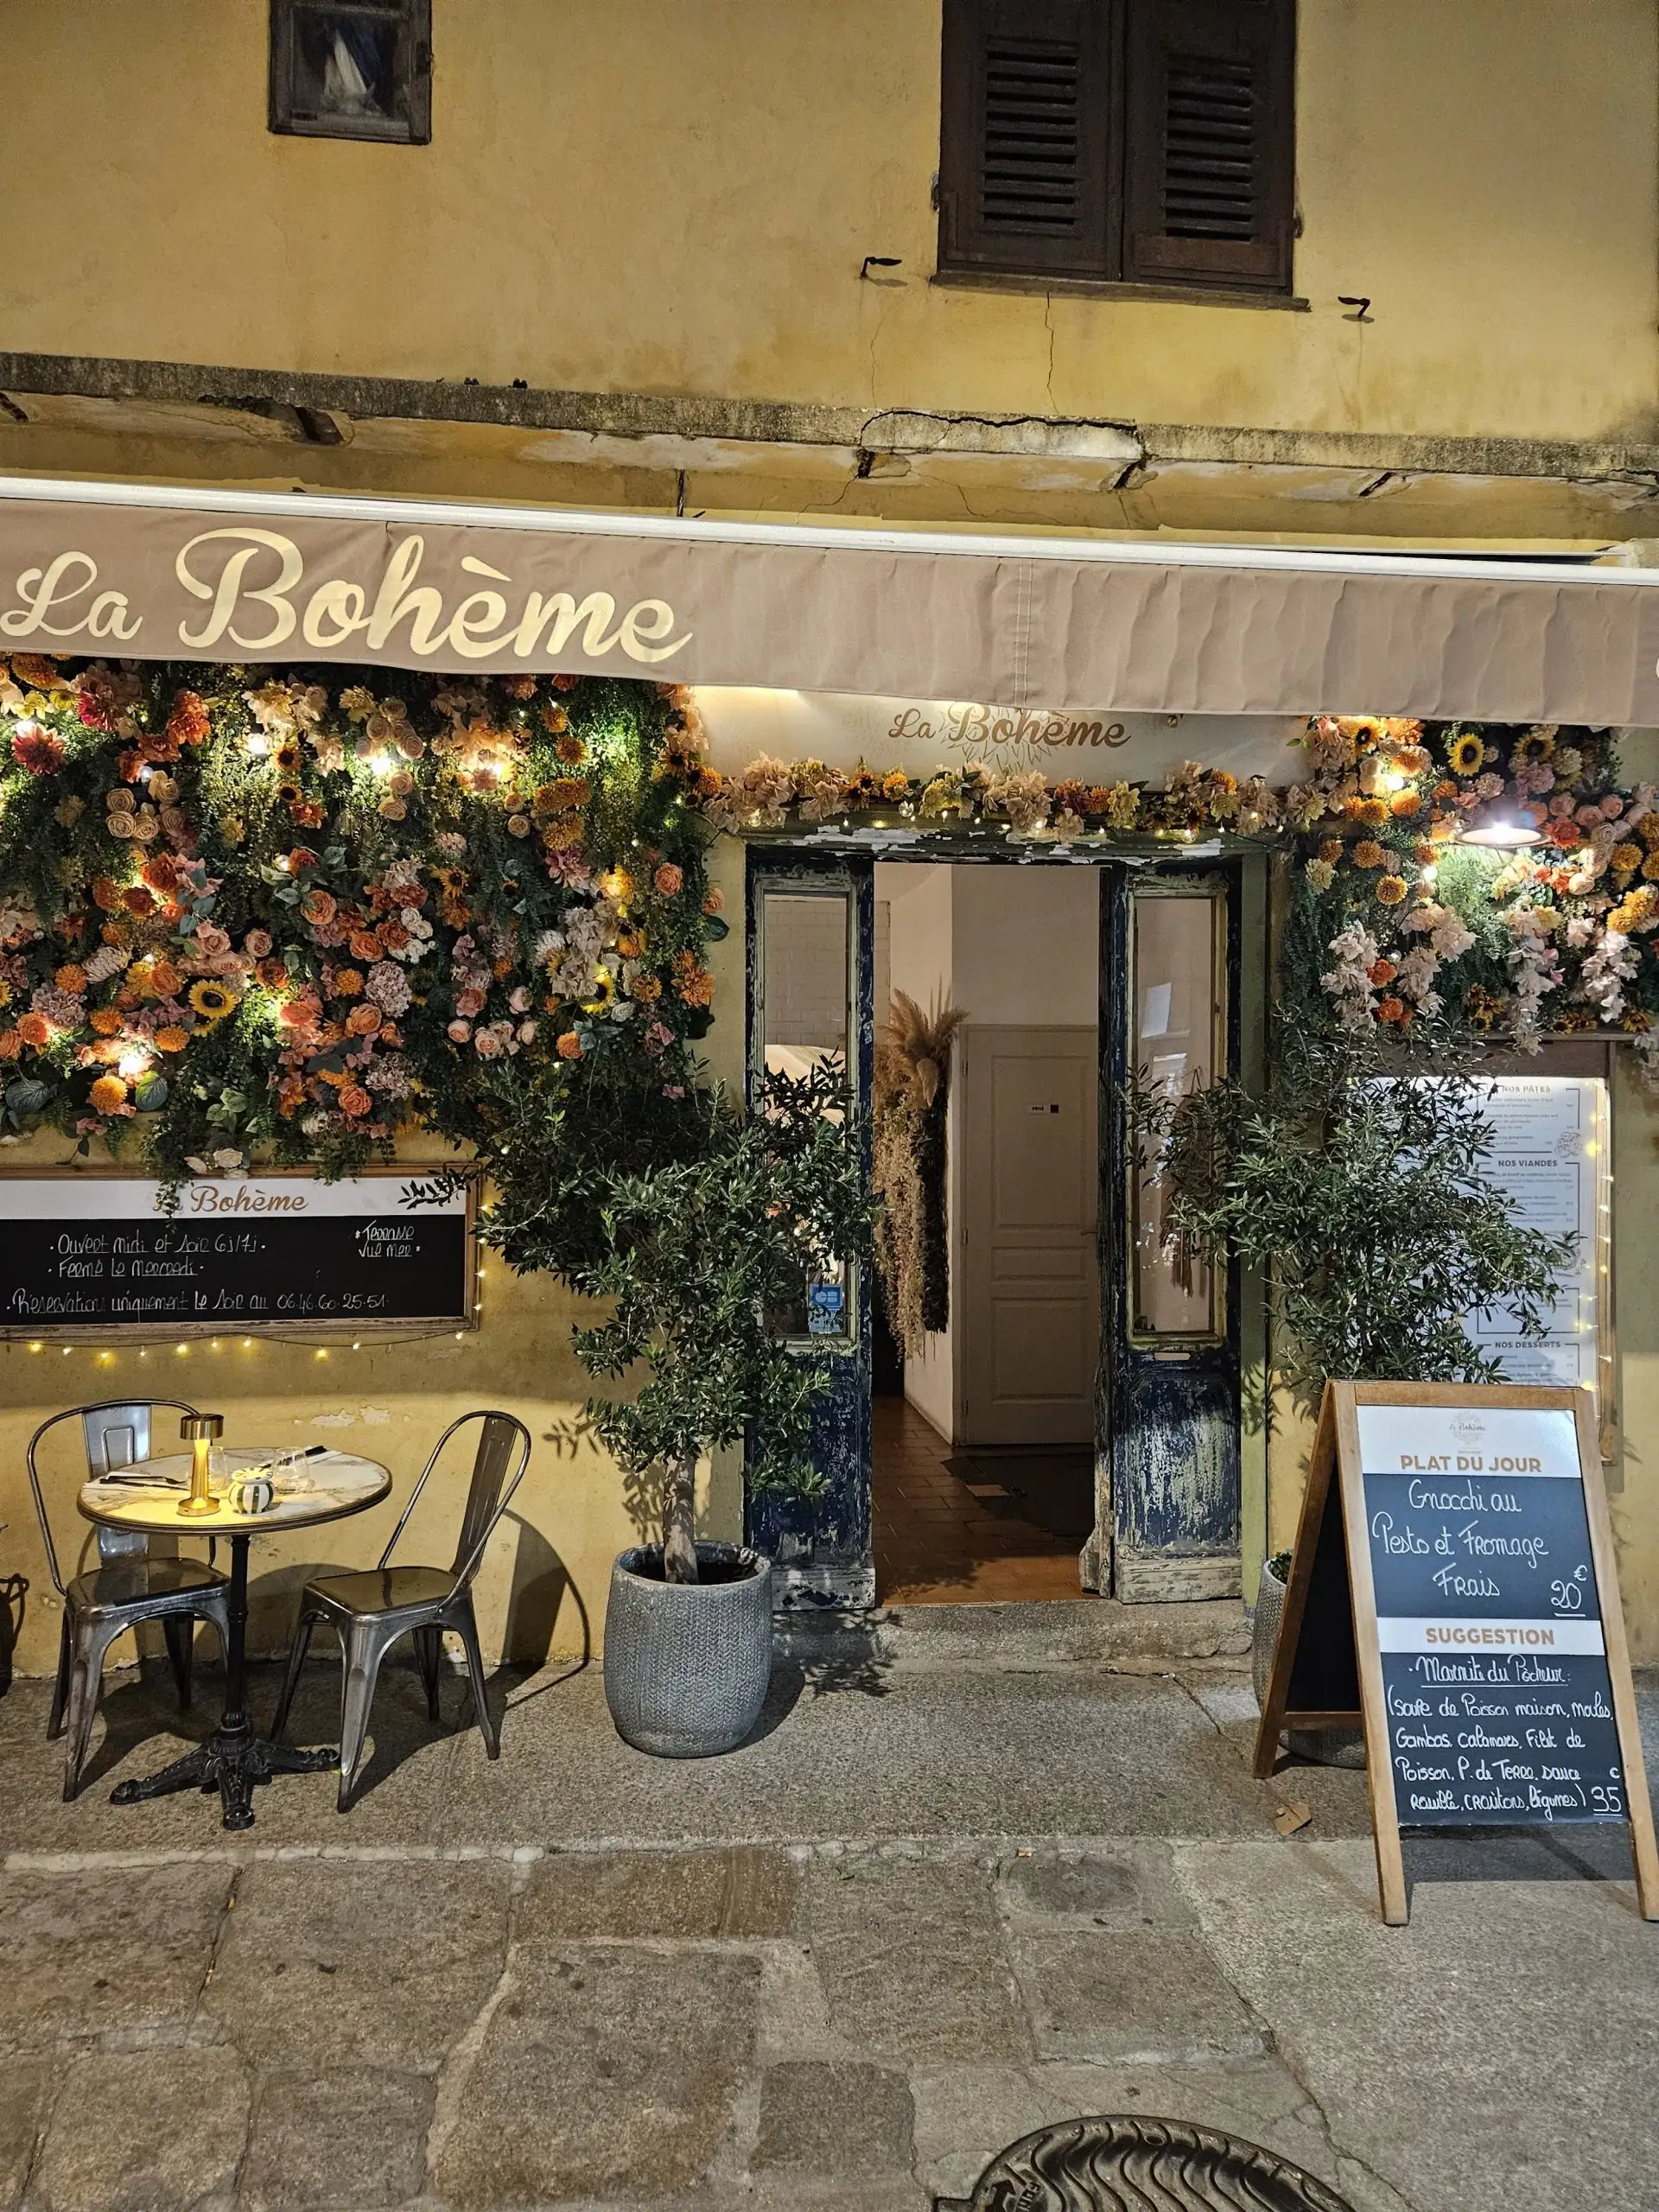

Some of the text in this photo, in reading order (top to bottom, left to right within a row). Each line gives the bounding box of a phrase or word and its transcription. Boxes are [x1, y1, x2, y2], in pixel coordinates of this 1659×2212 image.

[0, 526, 693, 663] La Bohème
[888, 708, 937, 740] La
[190, 1185, 308, 1212] Bohème
[113, 1229, 149, 1254] midi
[155, 1234, 173, 1253] et
[1515, 1340, 1561, 1349] DESSERTS
[1400, 1454, 1542, 1472] PLAT DU JOUR
[1408, 1478, 1522, 1512] Gnocchi au
[1372, 1511, 1429, 1554] Pesto
[1435, 1526, 1455, 1555] et
[1425, 1627, 1554, 1646] SUGGESTION
[1487, 1660, 1510, 1681] du
[1439, 1696, 1459, 1717] de
[1460, 1693, 1510, 1717] Poisson
[1566, 1727, 1586, 1748] de
[1475, 1758, 1494, 1781] de
